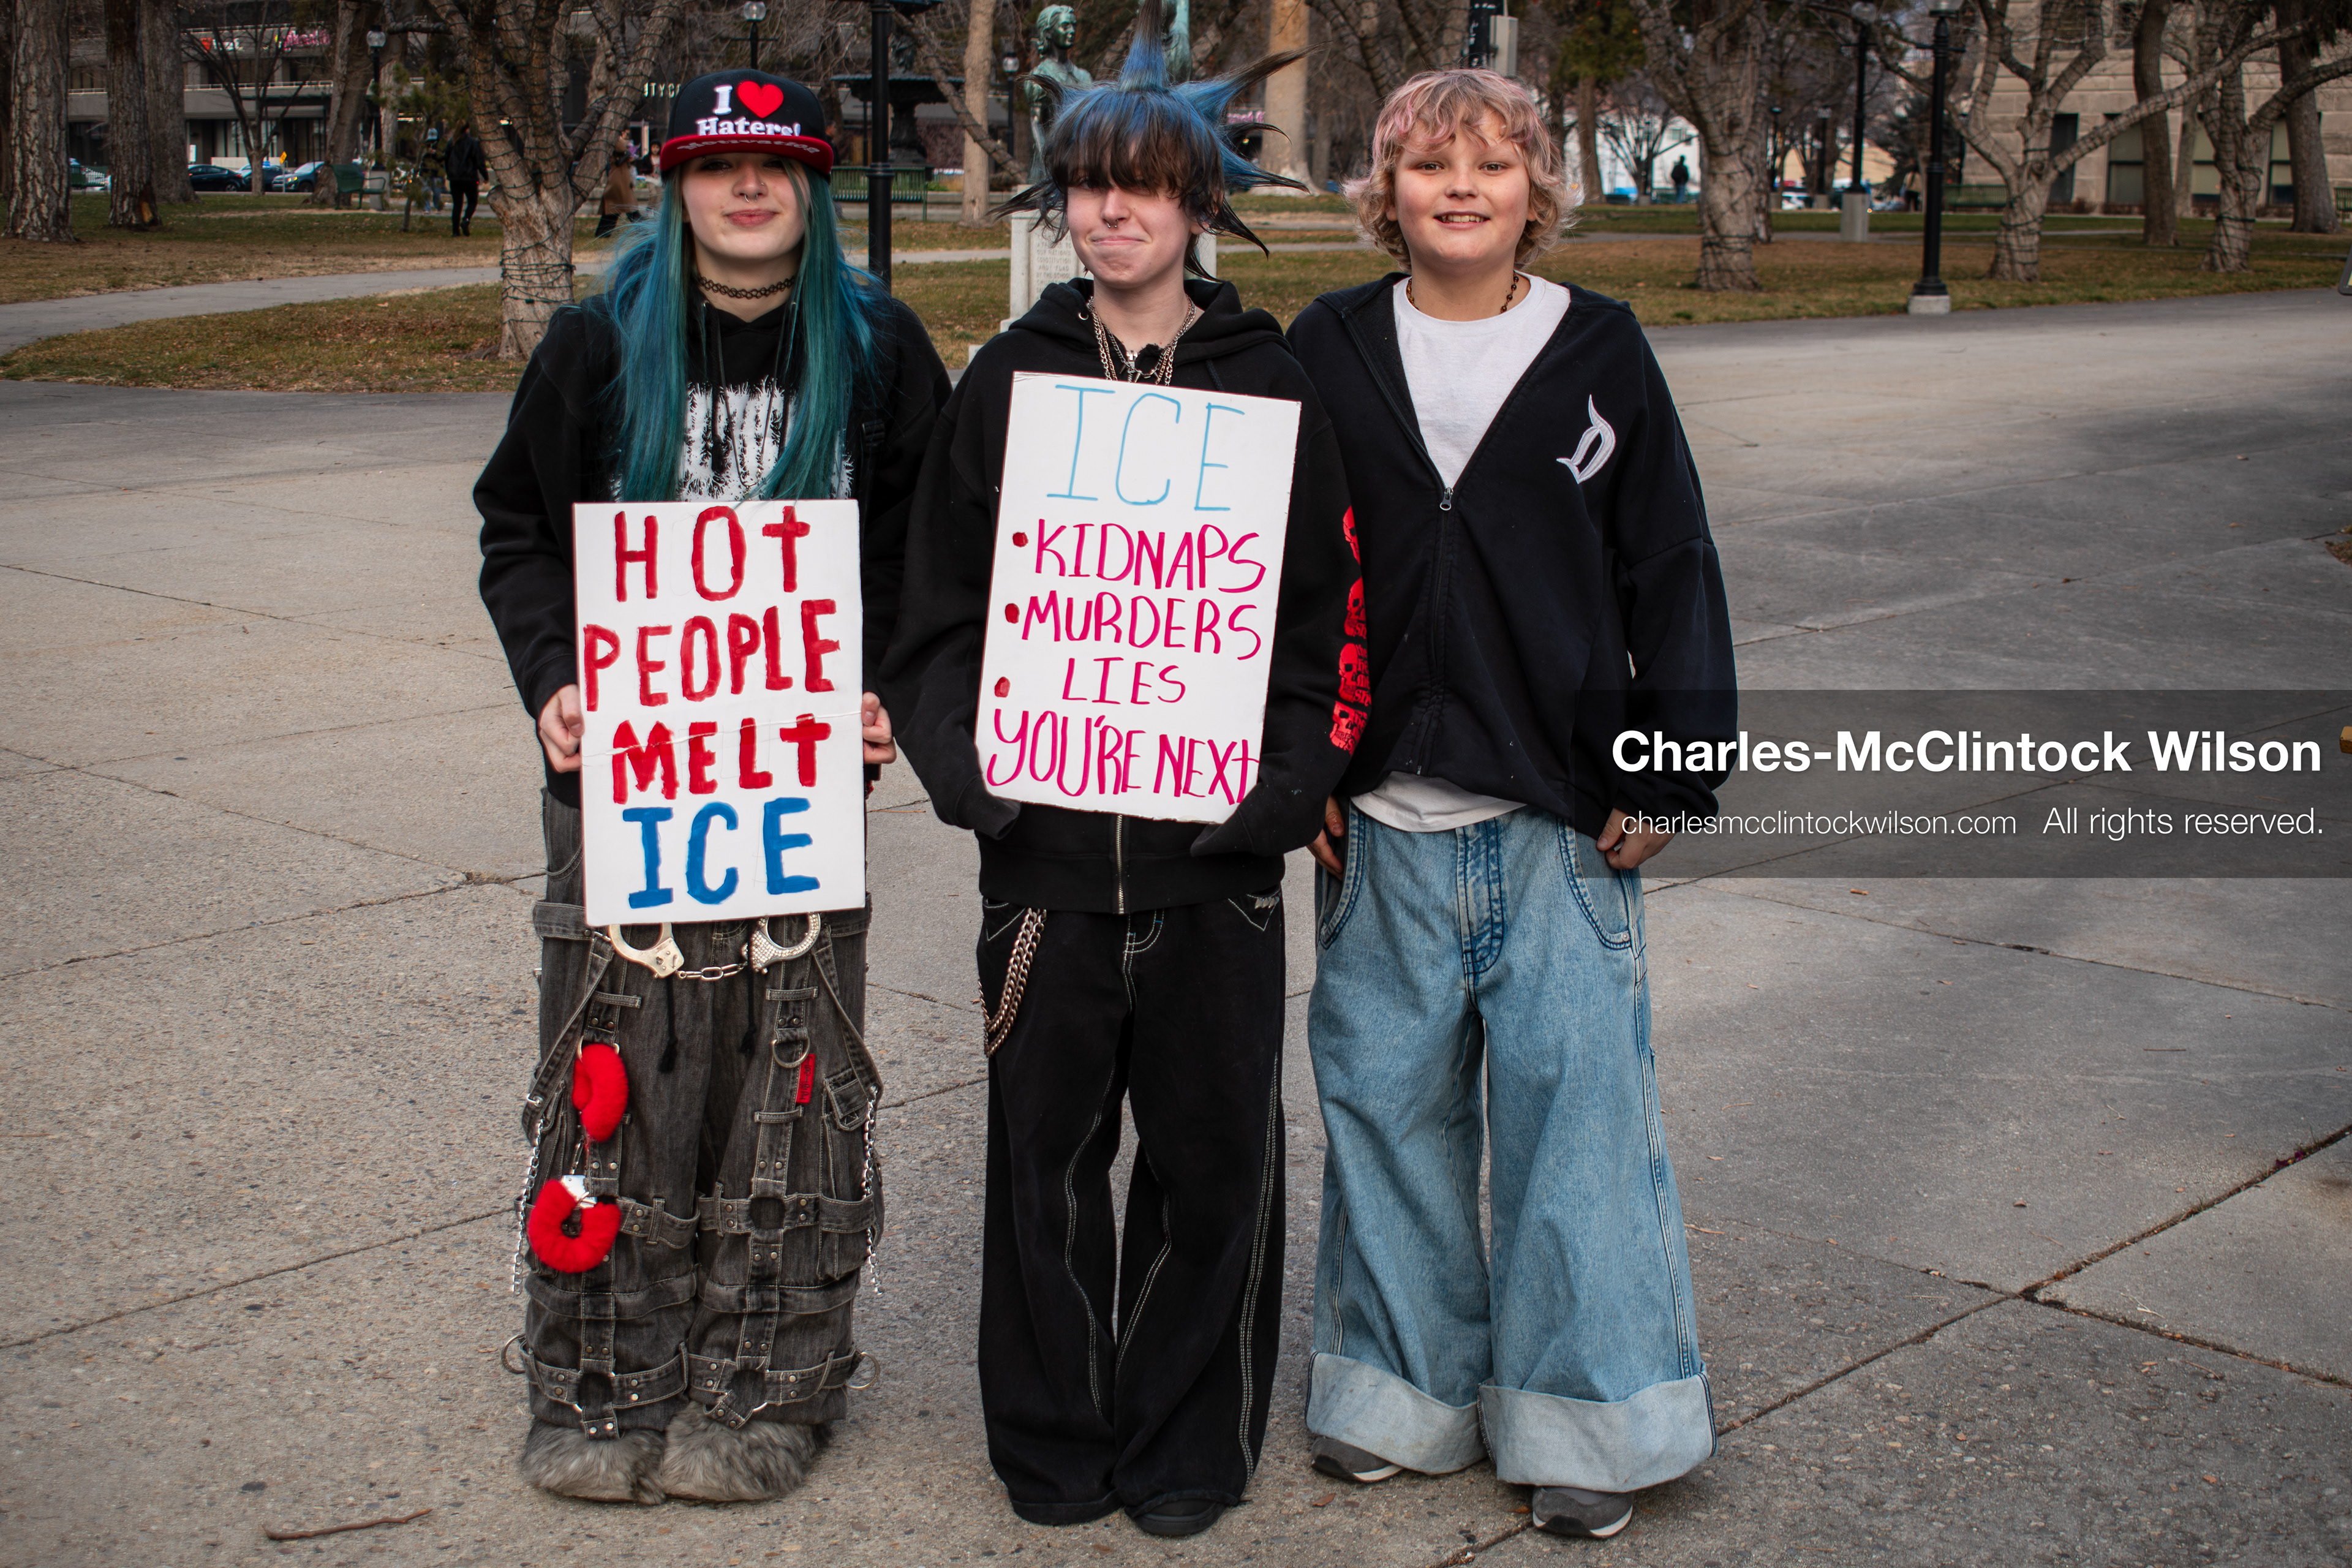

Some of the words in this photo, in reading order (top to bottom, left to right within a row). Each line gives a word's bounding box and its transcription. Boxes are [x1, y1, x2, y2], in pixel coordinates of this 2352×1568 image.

[714, 85, 733, 115] I
[1047, 385, 1245, 511] ICE
[615, 506, 810, 602] HOT
[1035, 519, 1266, 593] KIDNAPS
[583, 599, 840, 712] PEOPLE
[1022, 590, 1261, 660] MURDERS
[1062, 657, 1186, 704] LIES
[612, 714, 832, 804] MELT
[987, 709, 1146, 796] YOU'RE
[1153, 734, 1260, 805] NEXT
[622, 797, 820, 909] ICE
